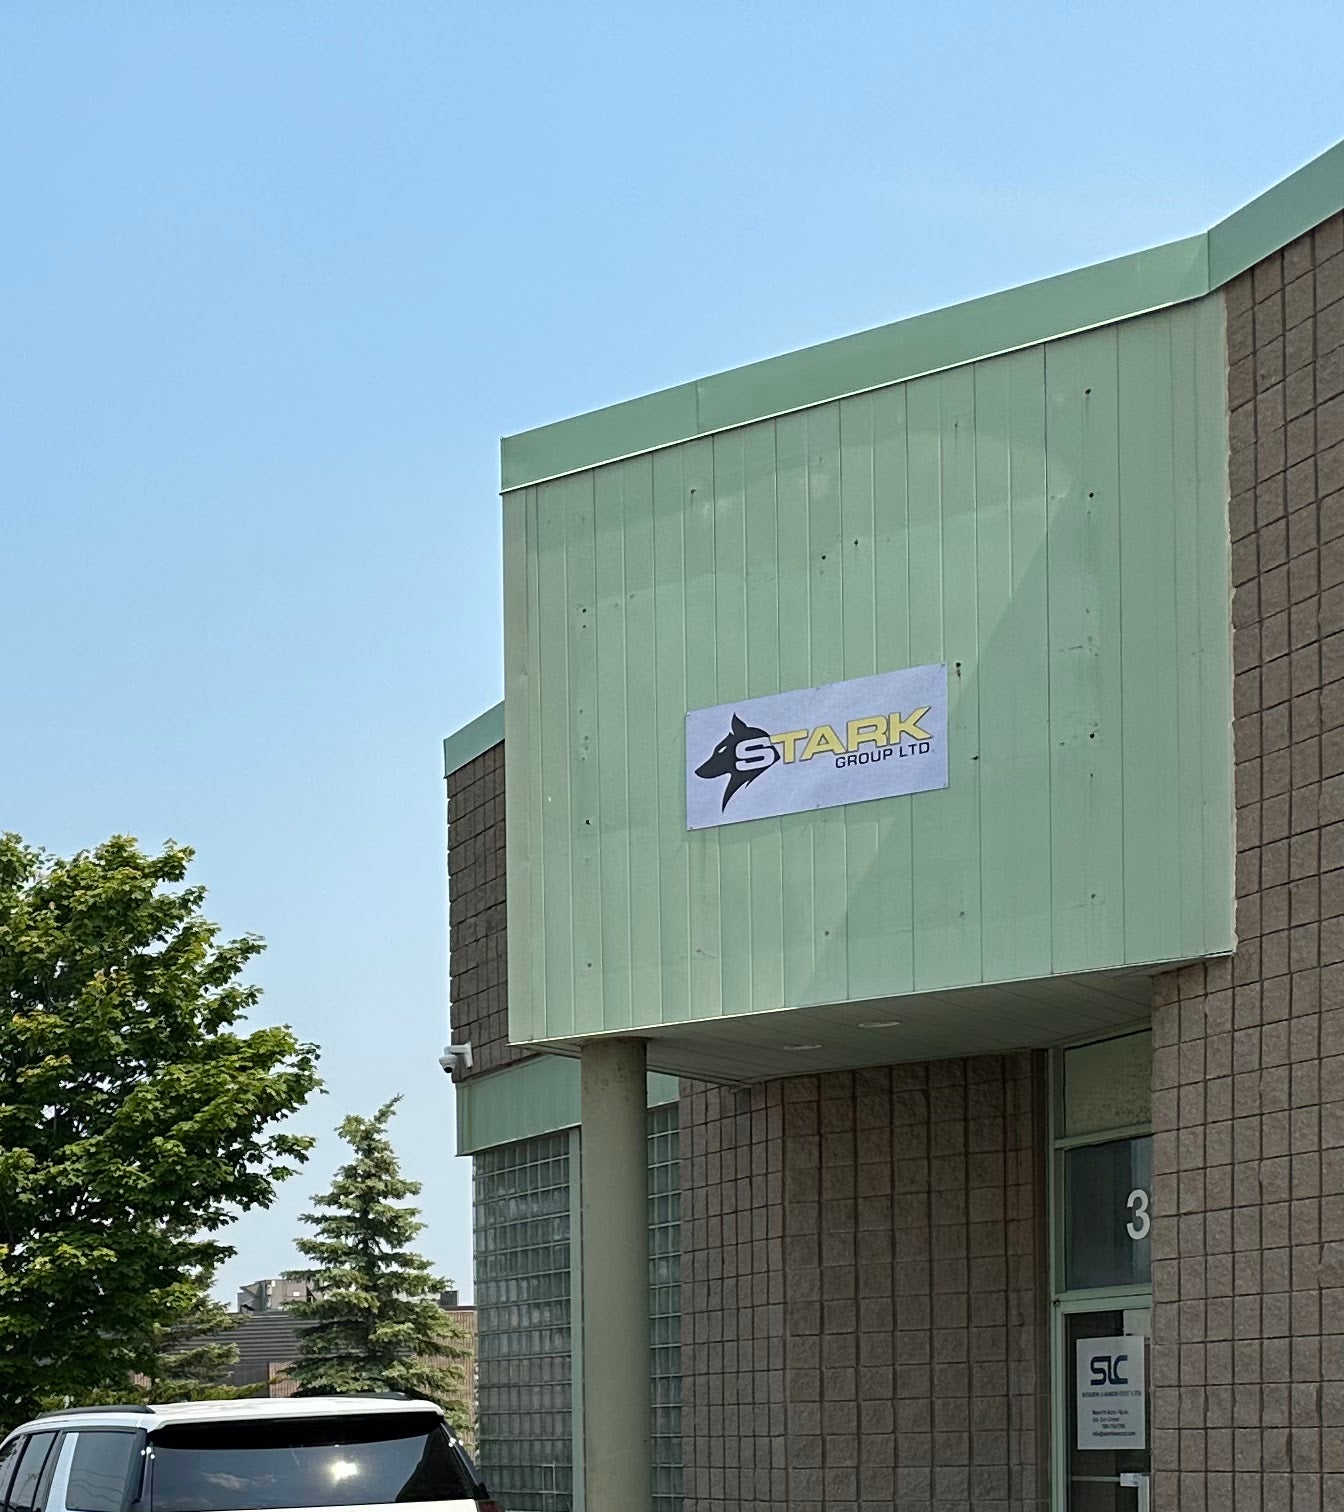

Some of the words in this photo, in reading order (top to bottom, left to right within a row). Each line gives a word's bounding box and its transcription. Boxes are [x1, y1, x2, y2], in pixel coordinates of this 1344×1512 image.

[735, 705, 933, 772] STARK
[835, 748, 893, 769] GROUP
[1126, 1189, 1150, 1240] 3
[1090, 1355, 1128, 1386] SLC
